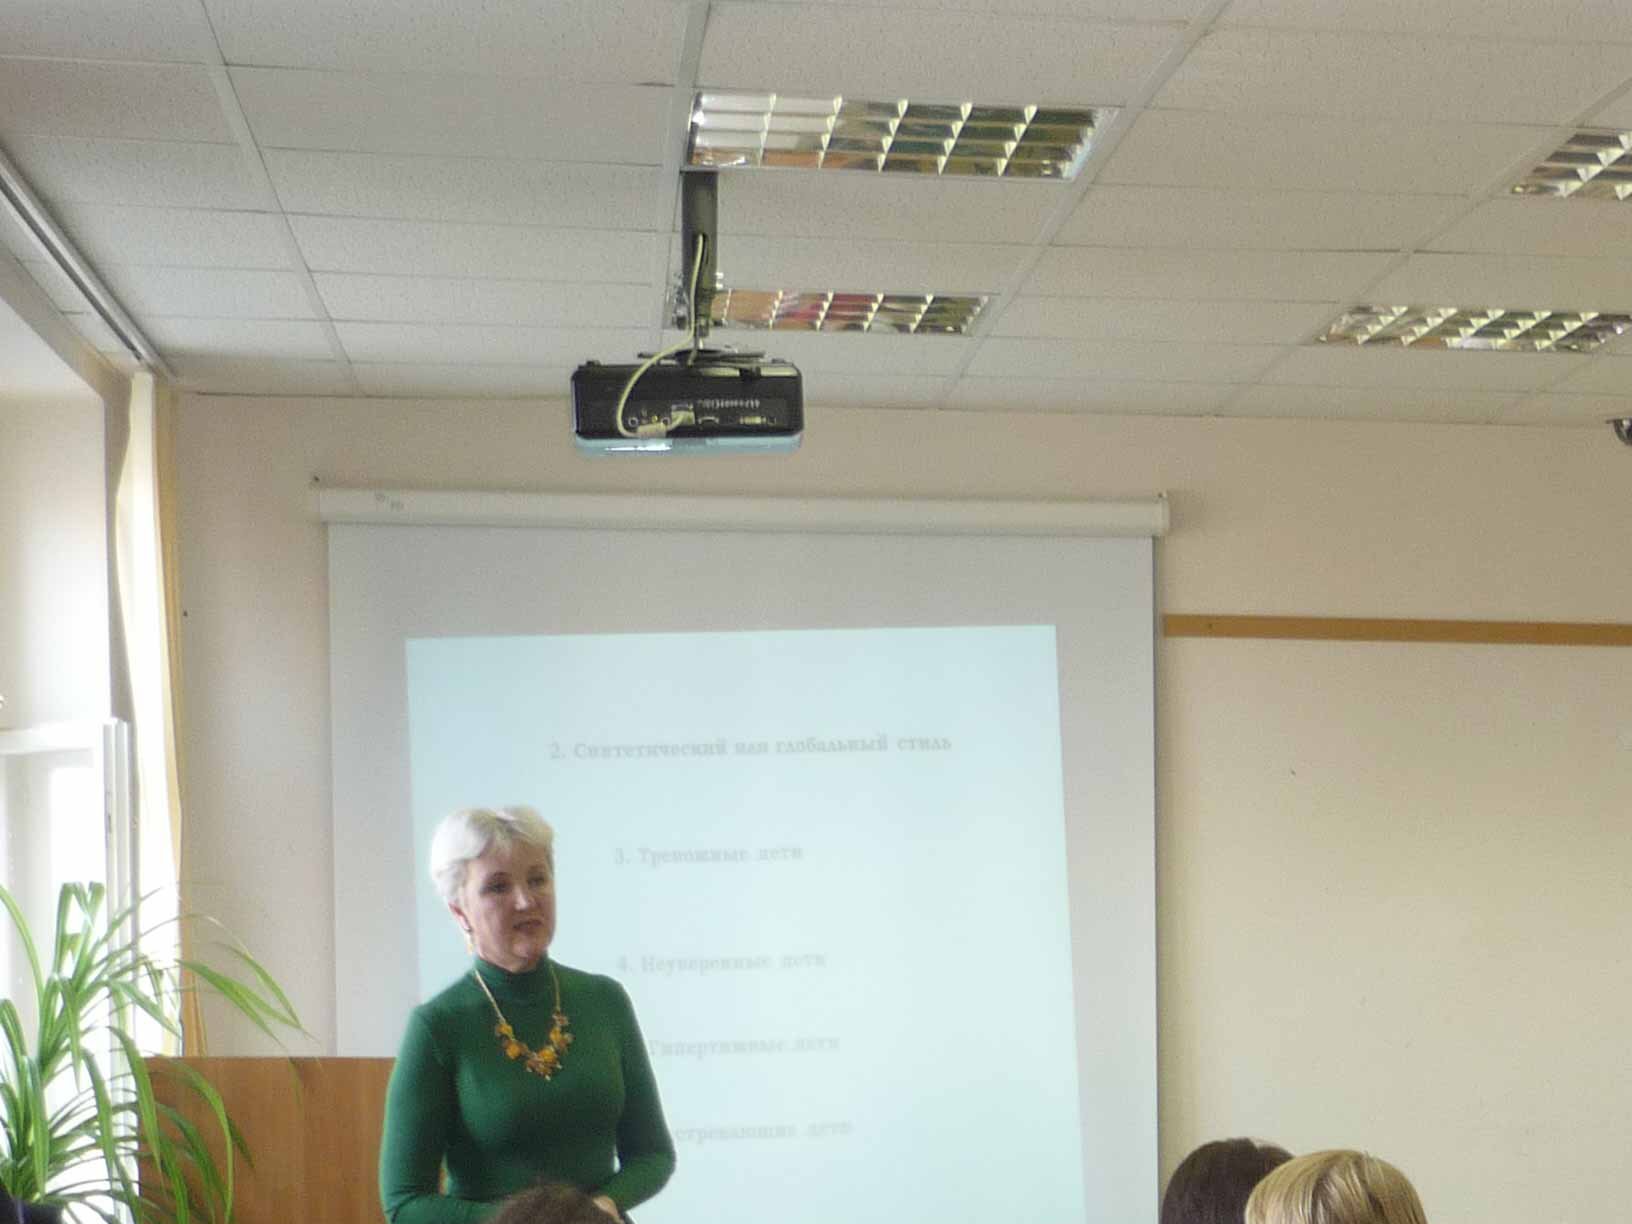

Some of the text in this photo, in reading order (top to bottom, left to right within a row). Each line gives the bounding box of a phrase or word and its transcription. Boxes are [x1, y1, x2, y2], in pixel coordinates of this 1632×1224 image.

[573, 737, 728, 760] Синтетический
[735, 740, 769, 756] или
[775, 731, 889, 754] глобальный
[896, 736, 953, 753] стиль
[638, 846, 750, 869] Тревожные
[756, 845, 805, 863] дети
